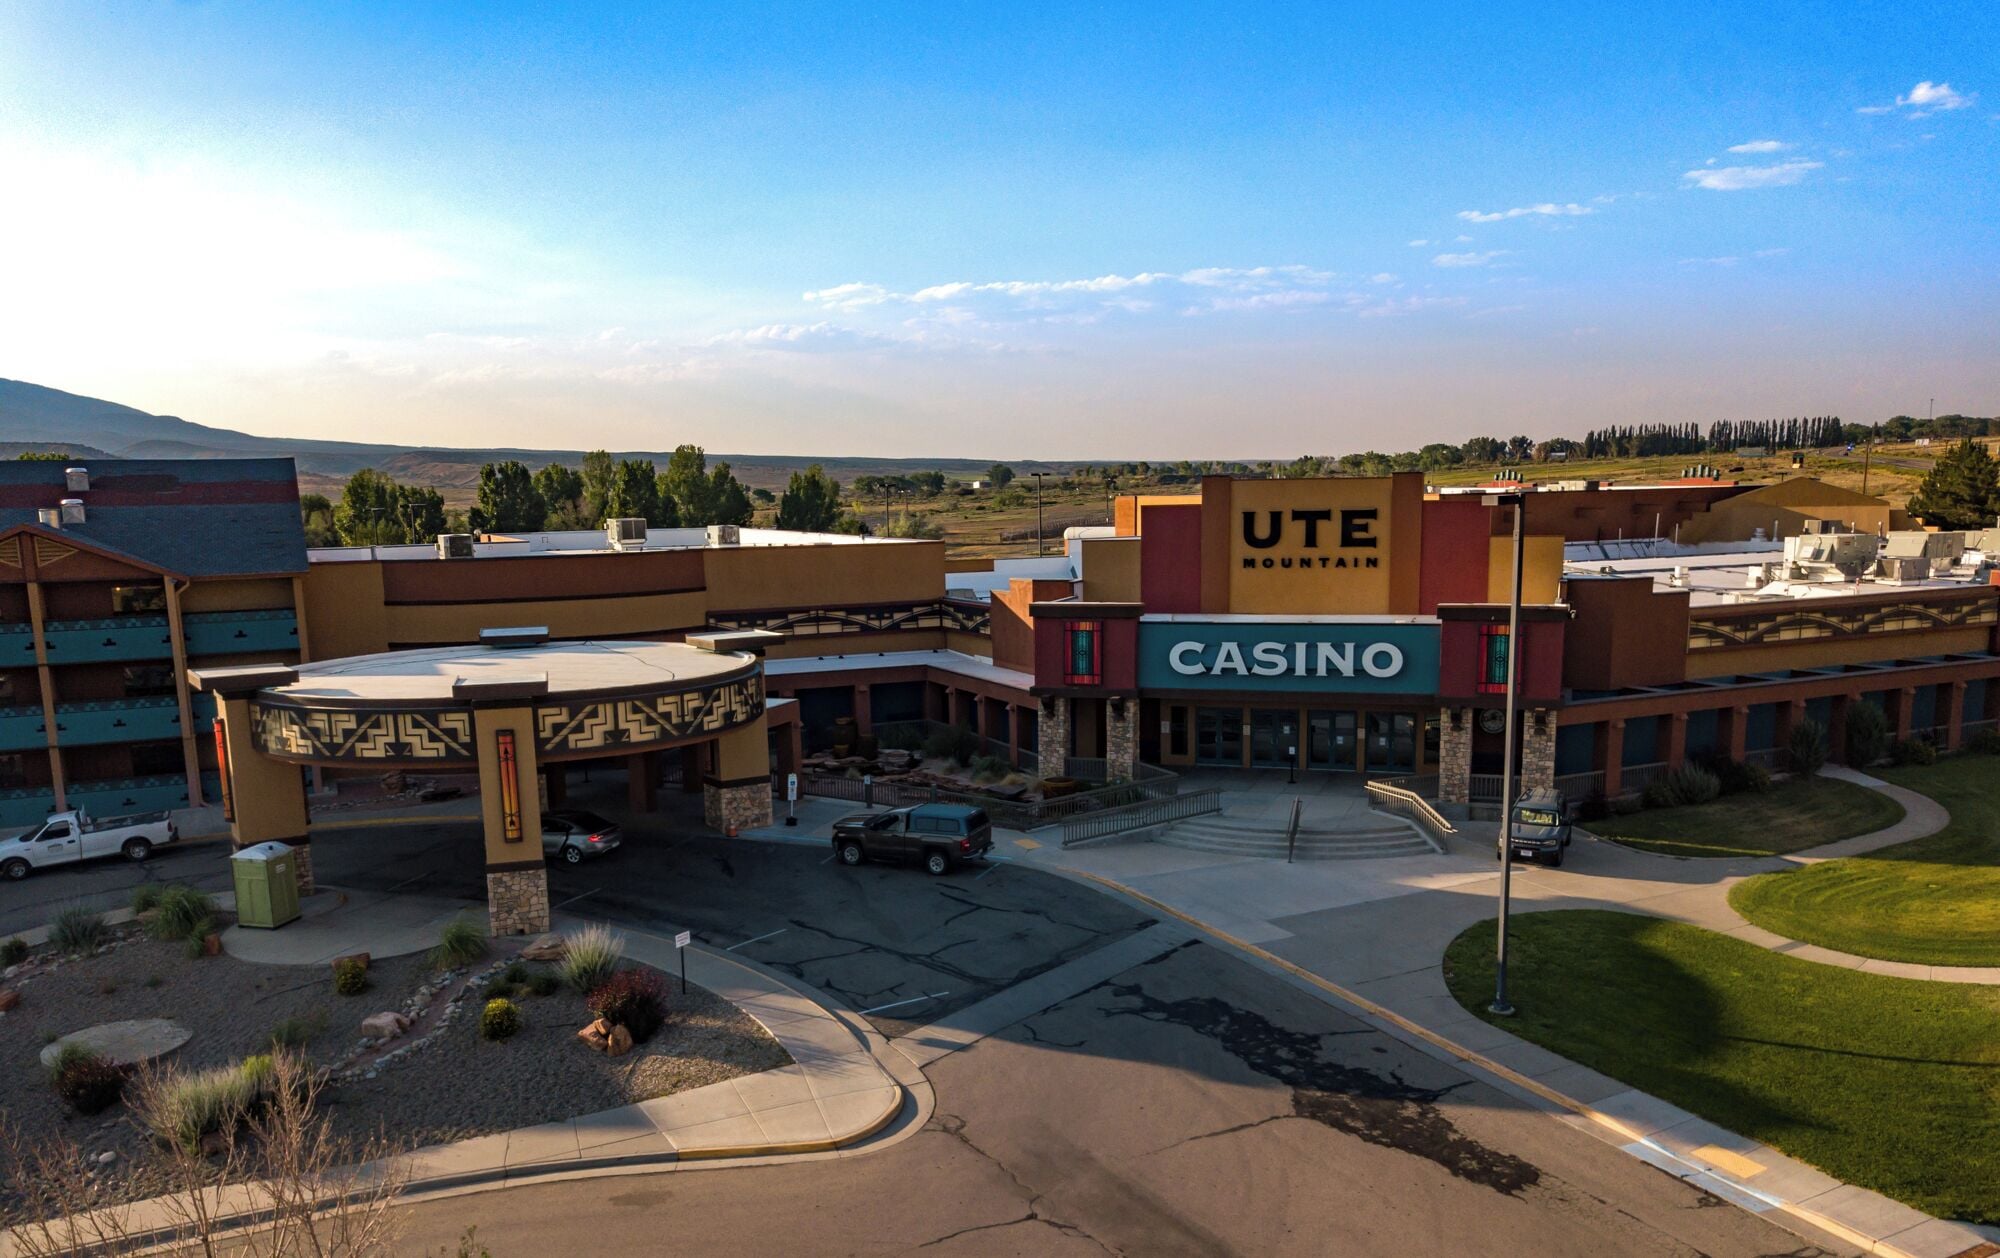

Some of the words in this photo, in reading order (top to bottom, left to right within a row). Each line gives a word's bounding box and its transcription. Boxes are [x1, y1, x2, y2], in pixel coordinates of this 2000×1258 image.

[1242, 509, 1378, 548] UTE
[1243, 557, 1378, 569] MOUNTAIN
[1169, 641, 1404, 678] CASINO
